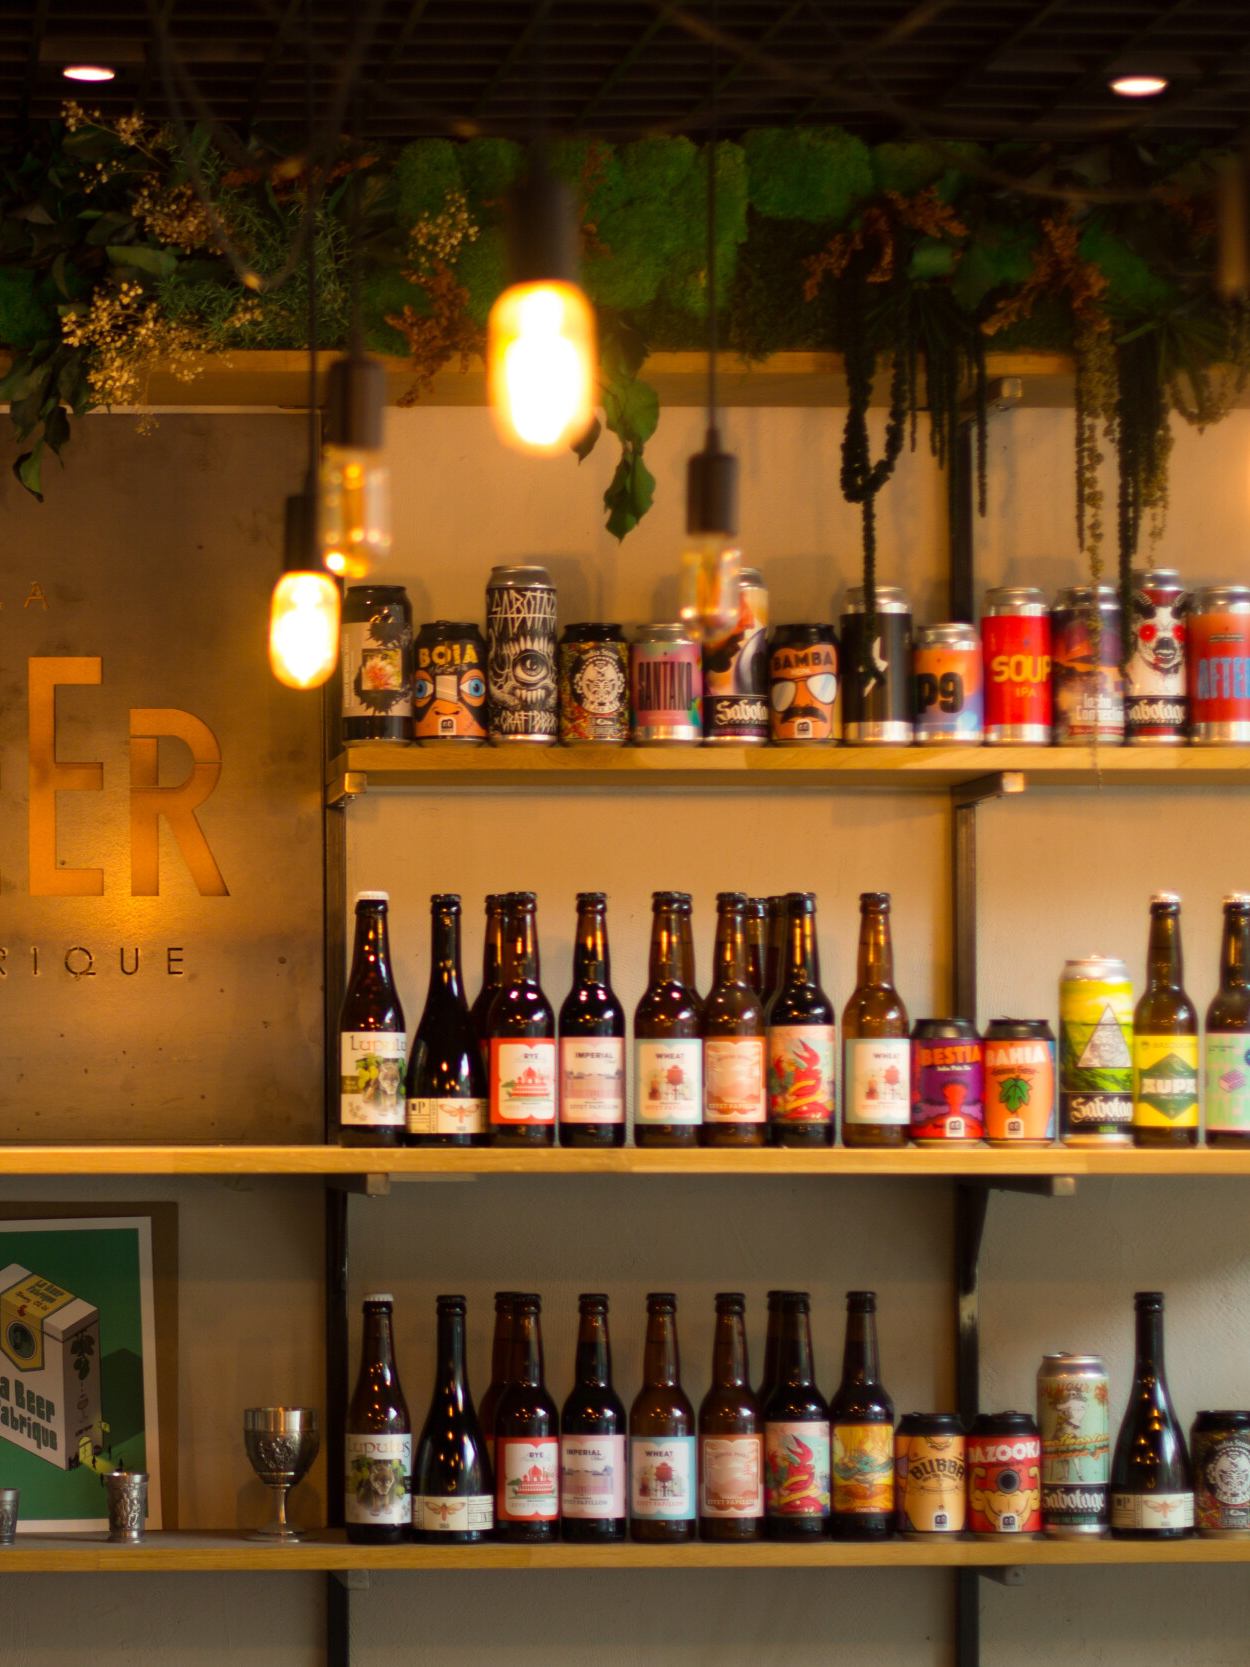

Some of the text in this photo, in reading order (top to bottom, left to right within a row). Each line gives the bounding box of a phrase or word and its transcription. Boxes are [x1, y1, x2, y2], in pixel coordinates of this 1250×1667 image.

[418, 643, 478, 669] BOIA
[772, 650, 834, 671] BAMBA
[1015, 687, 1037, 698] IPA
[920, 1045, 981, 1066] BESTIA
[14, 1378, 55, 1423] Beer
[566, 1449, 601, 1457] IMPERIAL
[910, 1459, 965, 1481] BUBBA
